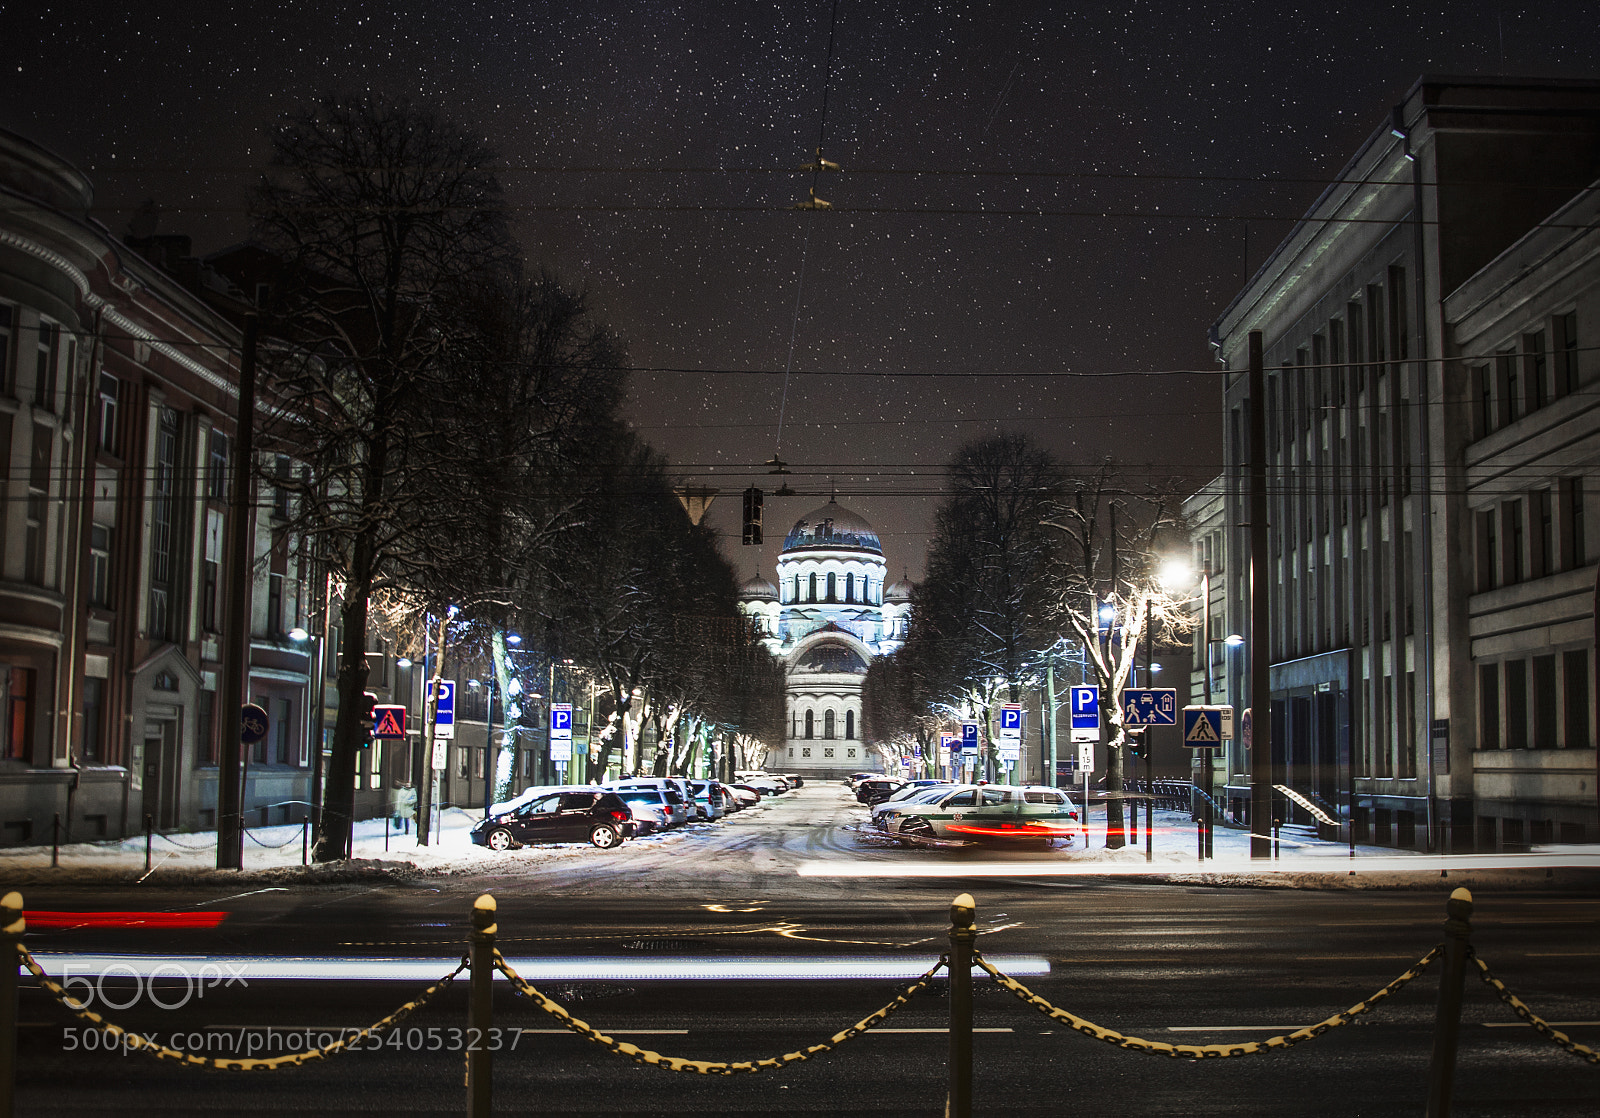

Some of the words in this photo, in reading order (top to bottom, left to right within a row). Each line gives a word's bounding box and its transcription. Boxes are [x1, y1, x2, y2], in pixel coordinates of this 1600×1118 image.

[1078, 690, 1094, 711] P
[557, 711, 568, 728] P
[1005, 711, 1017, 727] P
[966, 726, 975, 738] P
